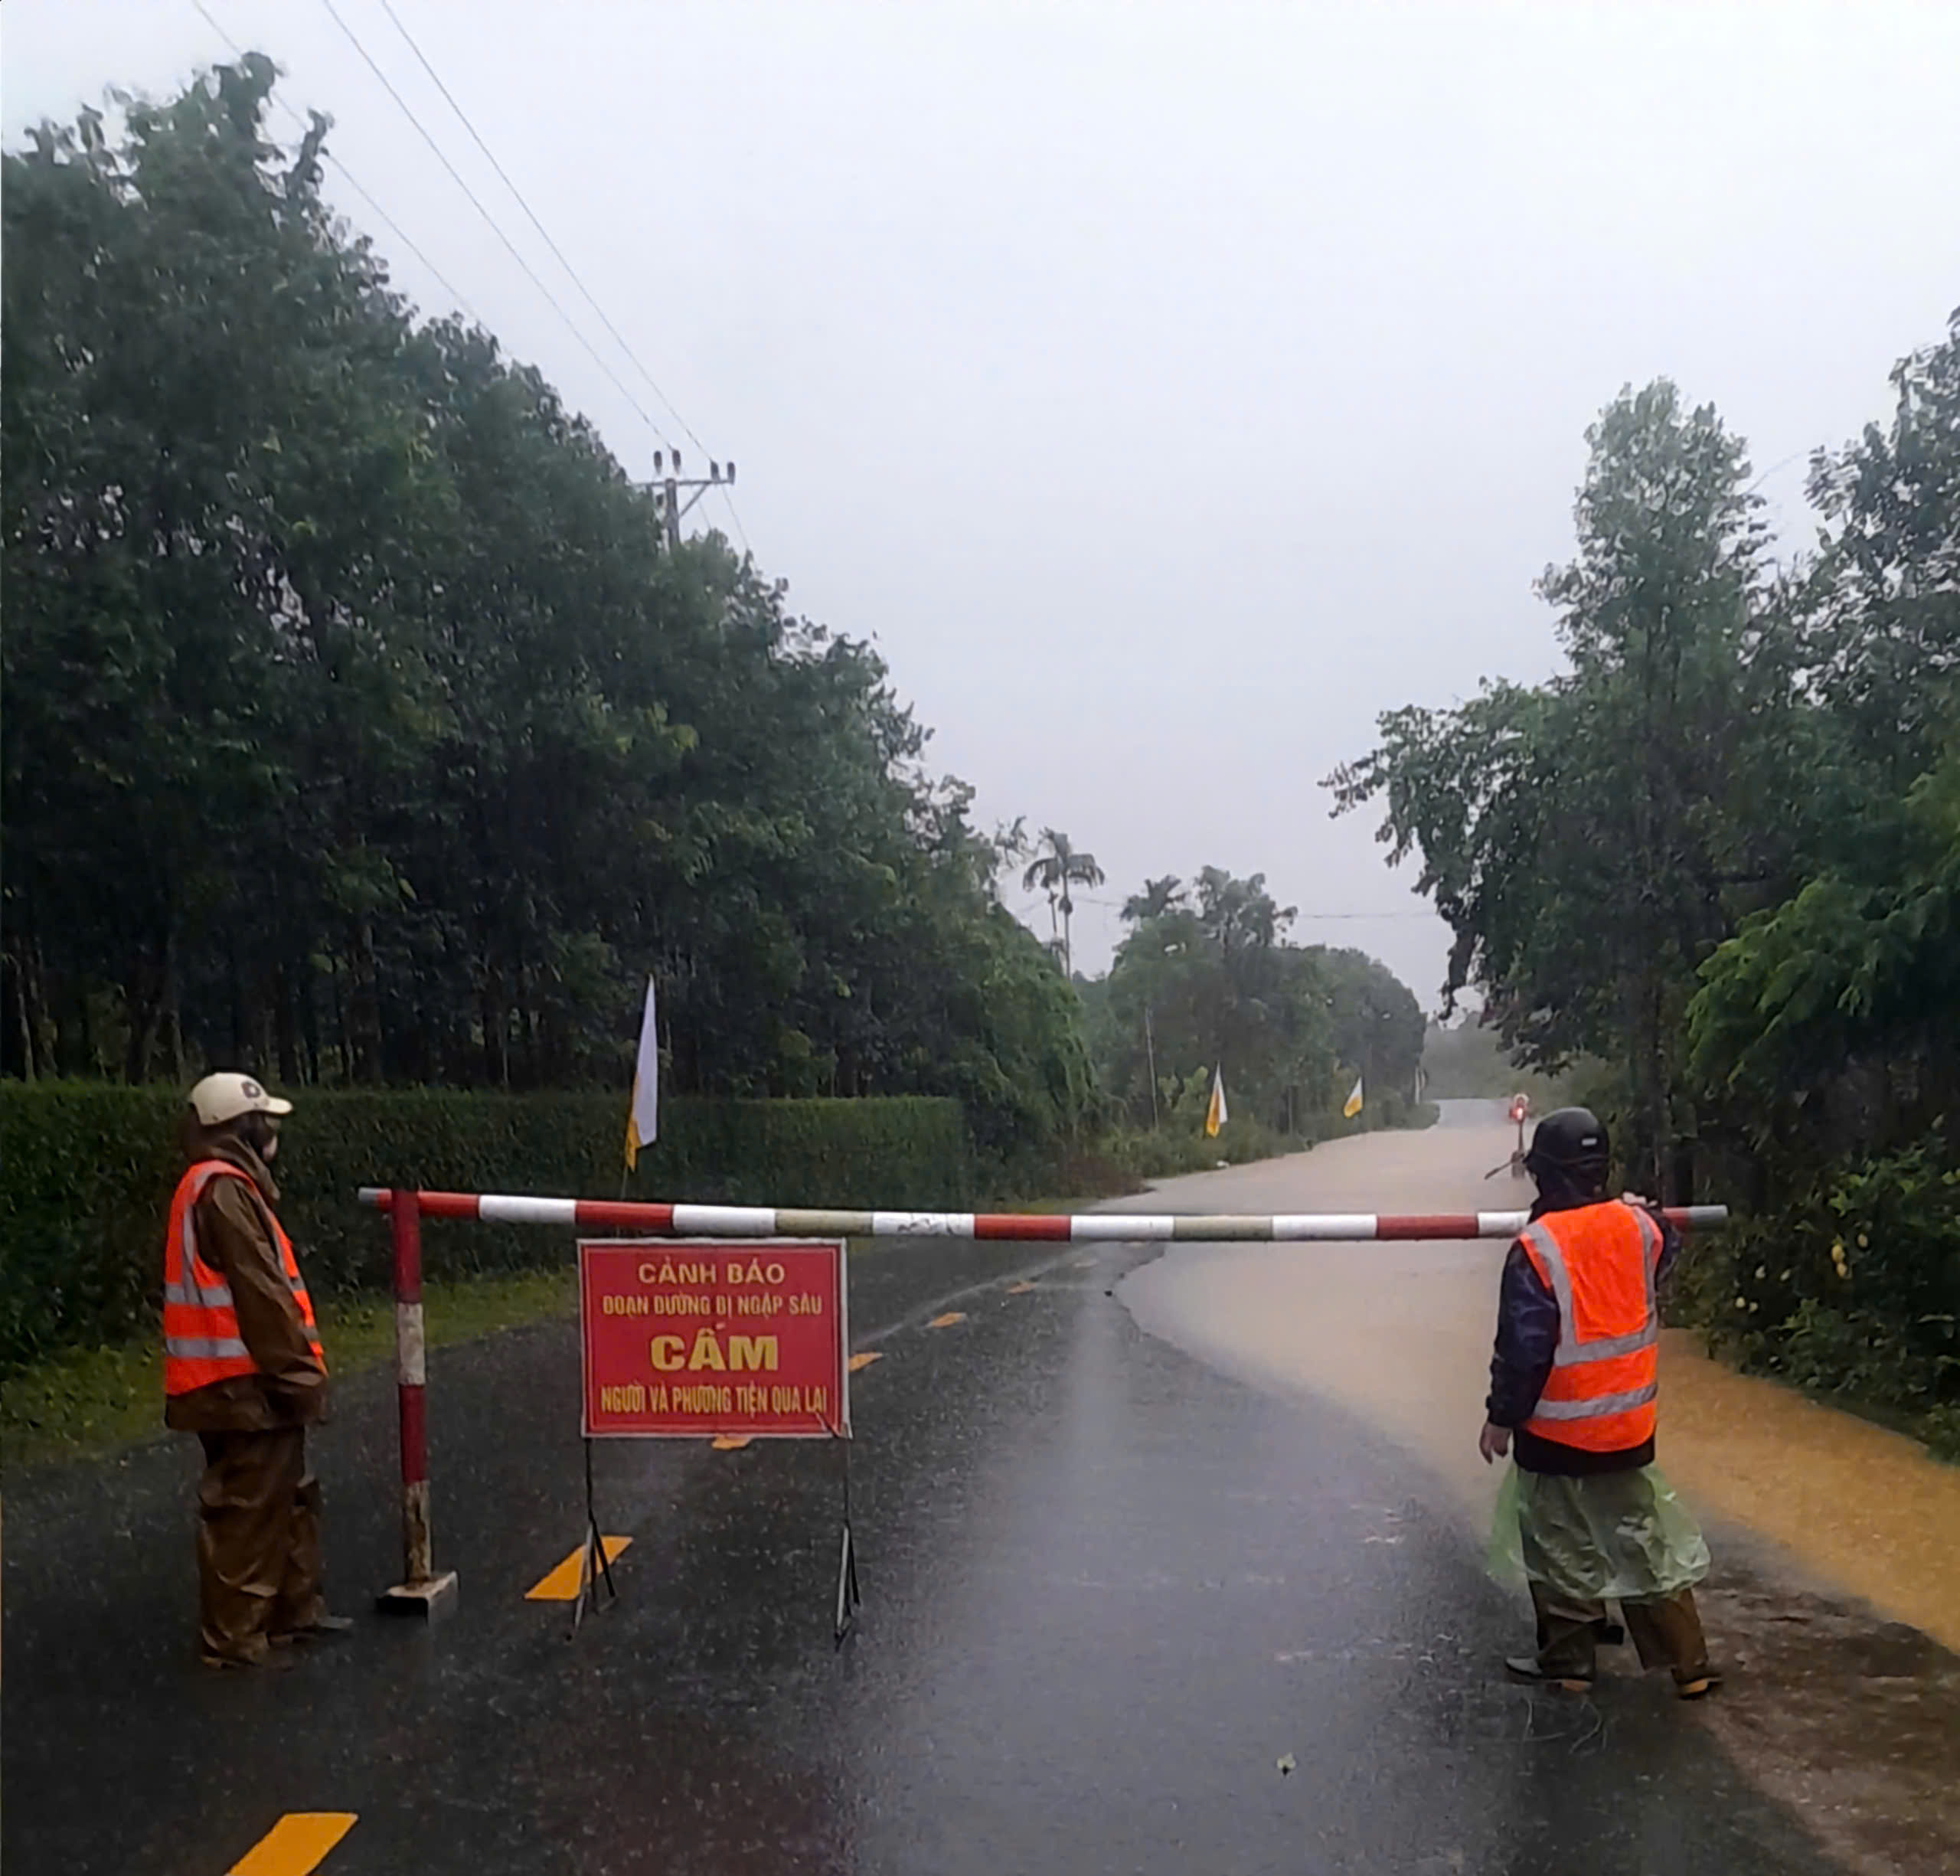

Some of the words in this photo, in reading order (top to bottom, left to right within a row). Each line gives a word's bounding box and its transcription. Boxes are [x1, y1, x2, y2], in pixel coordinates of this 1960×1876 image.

[639, 1256, 717, 1284] CẢNH
[727, 1257, 785, 1284] BÁO
[650, 1322, 779, 1371] CẤM
[772, 1385, 802, 1417] QUA
